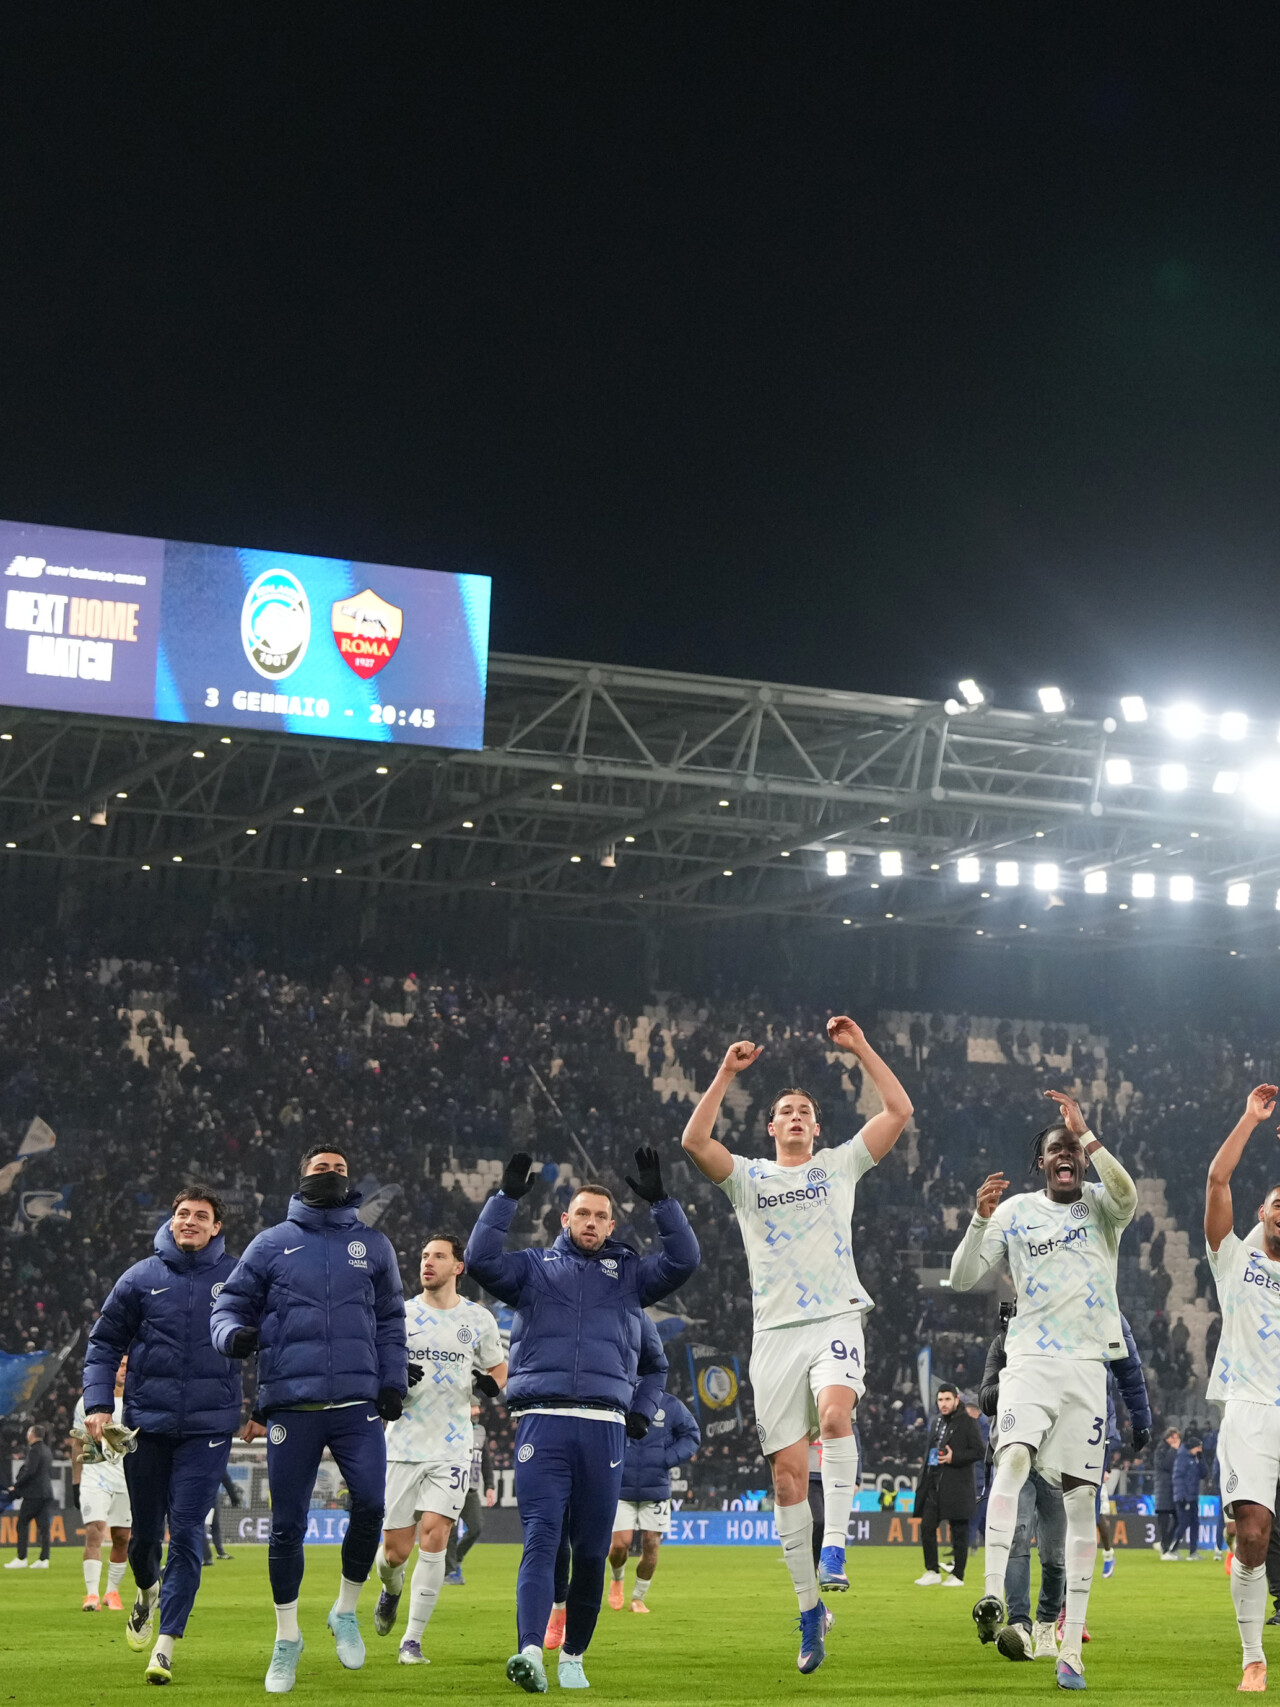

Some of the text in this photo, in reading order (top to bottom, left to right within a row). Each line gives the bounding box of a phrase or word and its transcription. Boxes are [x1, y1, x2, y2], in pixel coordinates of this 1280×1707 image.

[5, 589, 139, 642] NEXT HOME
[26, 634, 113, 681] MATCH
[259, 652, 288, 667] 1907
[341, 638, 390, 657] ROMA
[354, 657, 375, 668] 1927
[205, 687, 219, 708] 3
[232, 690, 330, 718] GENNAIO
[369, 704, 436, 728] 20:45
[757, 1185, 828, 1209] betsson
[1027, 1226, 1088, 1257] beton
[830, 1339, 861, 1369] 94
[449, 1466, 469, 1494] 30
